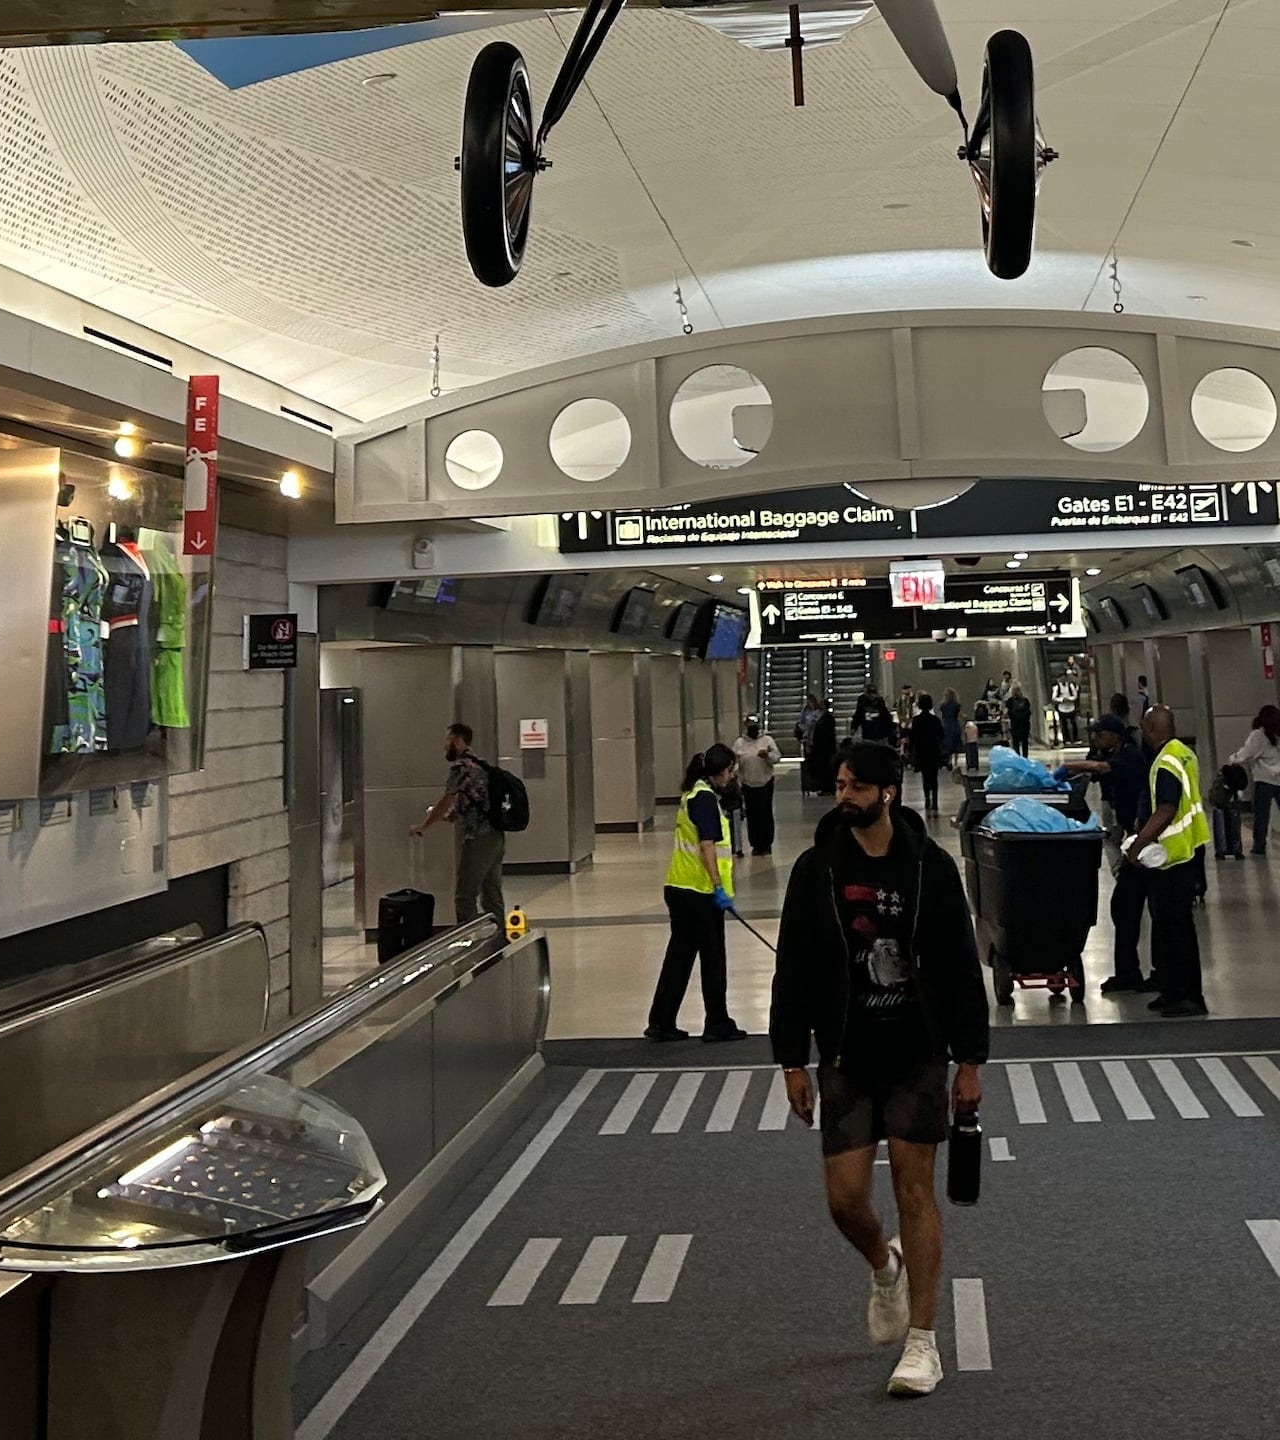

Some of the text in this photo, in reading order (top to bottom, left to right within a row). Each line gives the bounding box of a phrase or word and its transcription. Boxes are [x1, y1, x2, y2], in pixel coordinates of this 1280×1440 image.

[1058, 496, 1110, 514] Gates
[1115, 495, 1134, 511] E1
[1152, 494, 1187, 510] E42
[645, 505, 894, 532] International Baggage Claim
[1050, 515, 1086, 527] Puertas
[1087, 515, 1101, 526] de
[1102, 513, 1150, 525] Embarque
[1151, 513, 1161, 524] E1
[1169, 512, 1188, 523] E42
[687, 531, 700, 542] de
[798, 592, 837, 600] Concourse
[901, 576, 936, 604] EXIT
[983, 584, 1022, 594] Concourse
